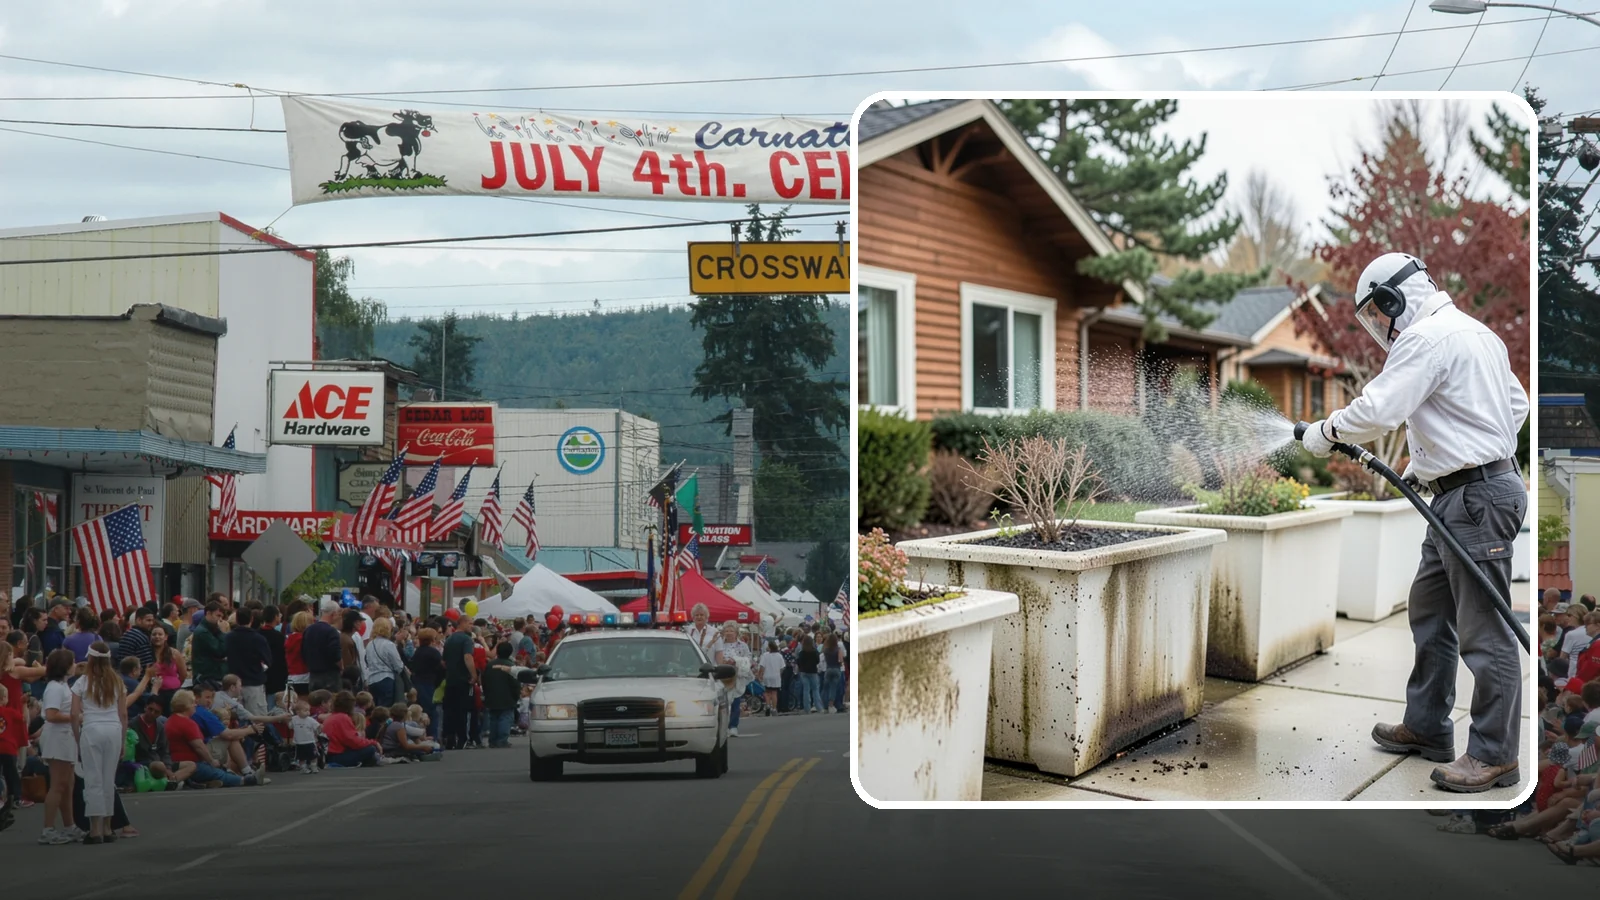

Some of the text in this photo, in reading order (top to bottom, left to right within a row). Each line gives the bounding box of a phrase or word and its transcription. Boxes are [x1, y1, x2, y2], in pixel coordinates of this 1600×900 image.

[694, 121, 850, 150] Carnat
[481, 141, 605, 193] JULY
[632, 150, 746, 198] 4th.
[696, 254, 850, 280] CROSSWA
[282, 379, 374, 420] ACE
[405, 409, 485, 422] CEDAR LOG
[283, 421, 371, 437] Hardware
[353, 467, 385, 480] Simpl
[83, 485, 155, 495] St. Vincent de Paul
[212, 516, 330, 536] HARDARE
[688, 526, 741, 535] CRNATION
[699, 535, 730, 543] GLASS
